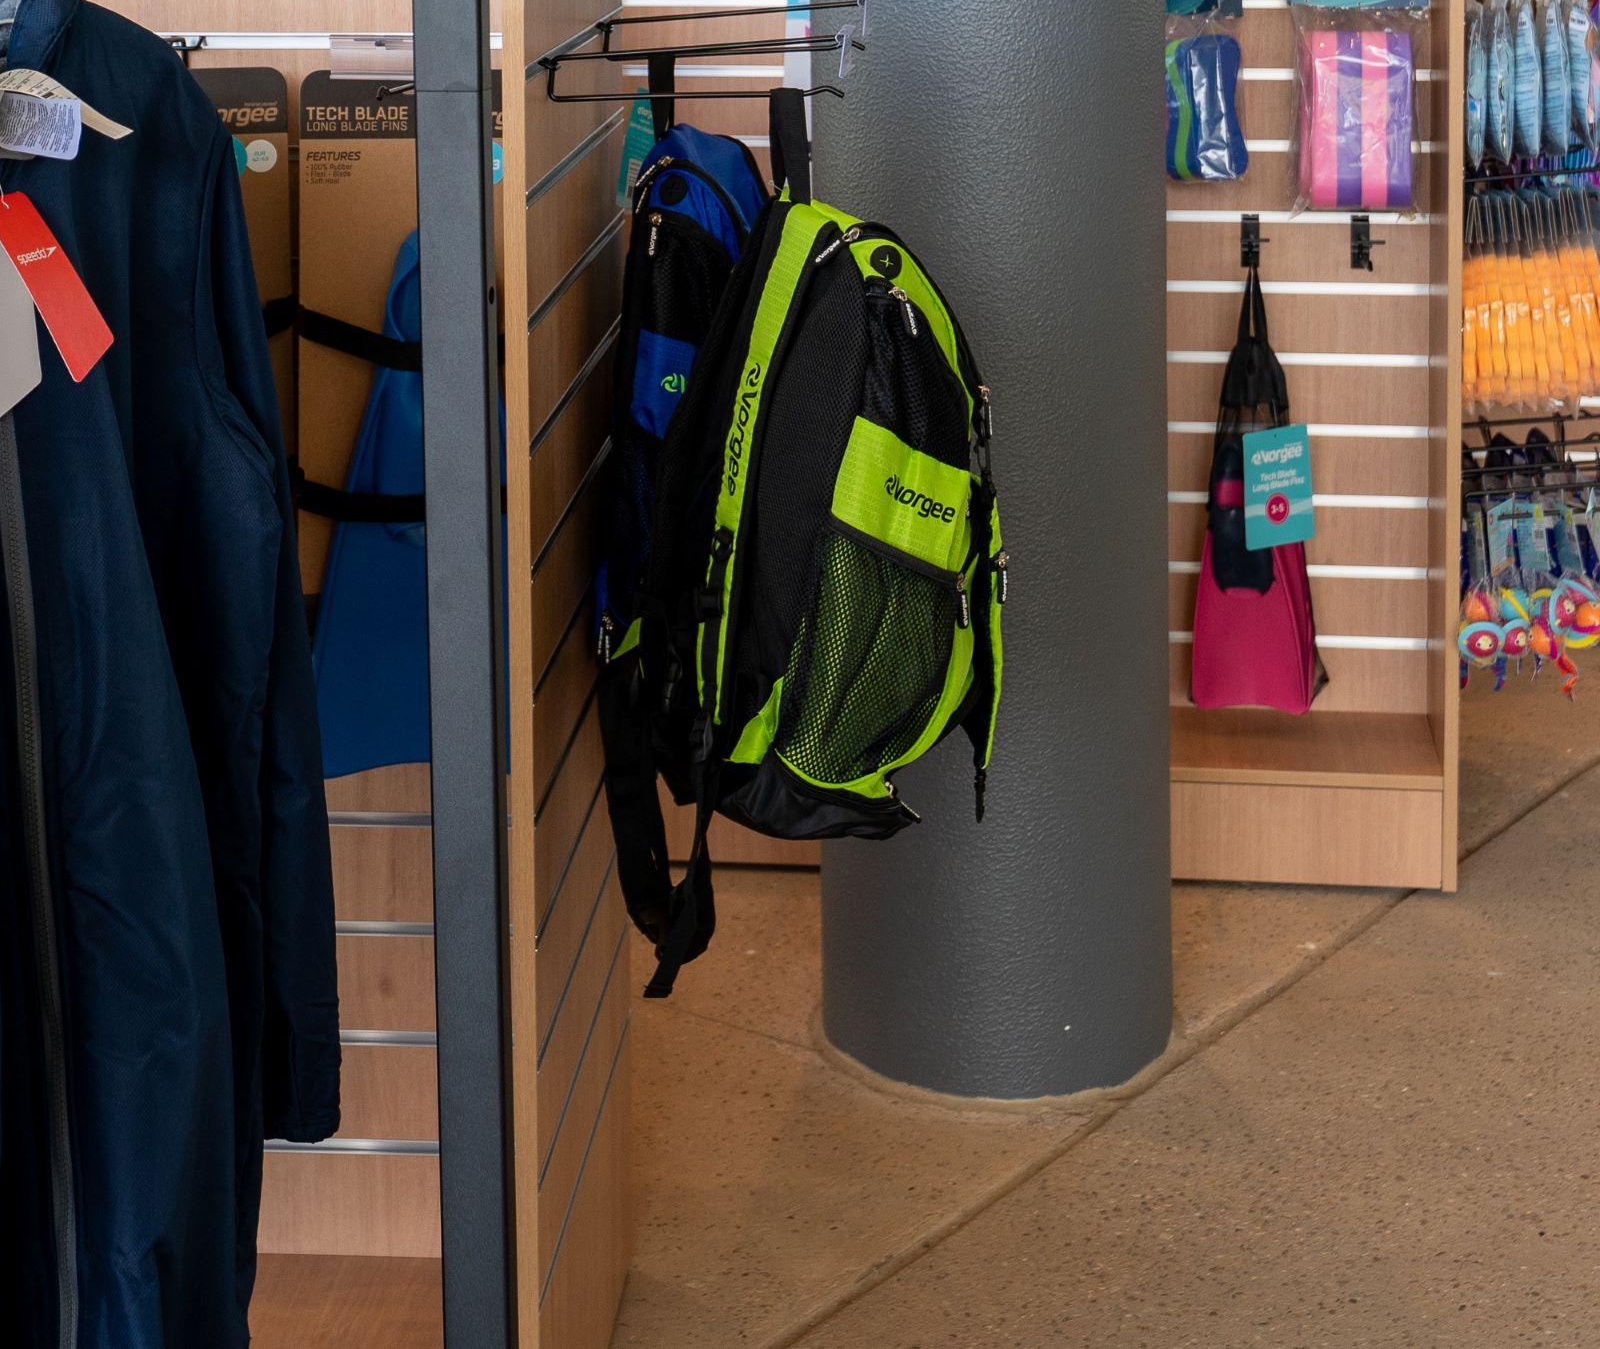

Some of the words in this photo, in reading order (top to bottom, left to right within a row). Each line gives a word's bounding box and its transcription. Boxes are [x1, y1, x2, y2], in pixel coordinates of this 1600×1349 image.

[216, 107, 278, 127] orgee
[305, 106, 349, 121] TECH
[355, 106, 409, 120] BLADE
[306, 121, 337, 132] LONG
[340, 121, 378, 131] BLADE
[381, 120, 408, 131] FINS
[305, 151, 362, 162] FEATURES
[16, 247, 48, 266] speedo
